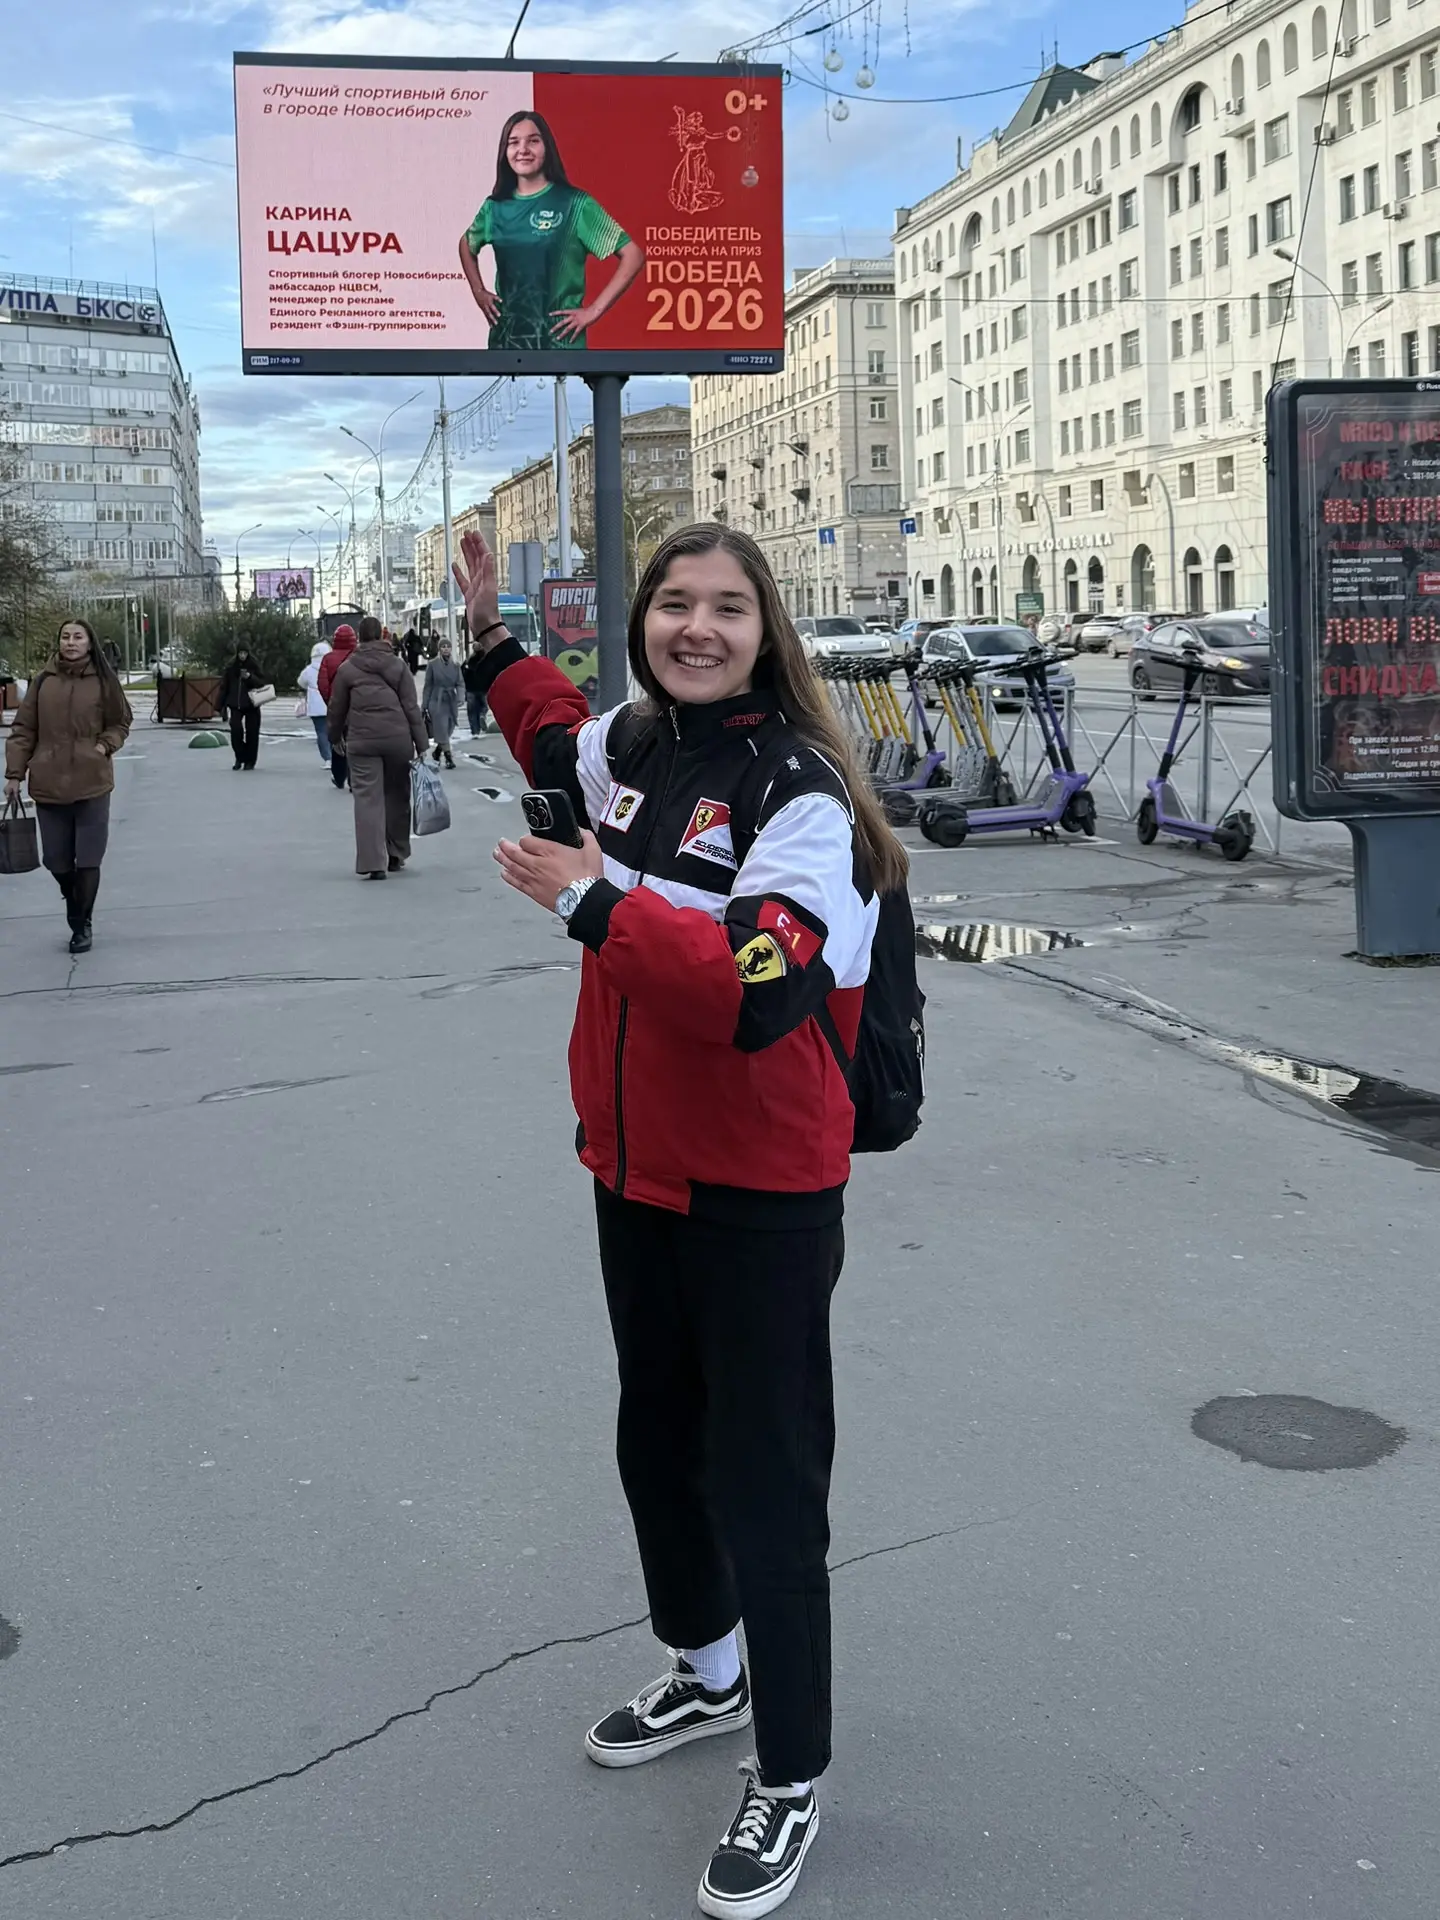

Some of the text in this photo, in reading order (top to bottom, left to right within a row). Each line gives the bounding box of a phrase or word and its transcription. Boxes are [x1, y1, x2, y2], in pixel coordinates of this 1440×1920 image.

[263, 84, 488, 101] «Лучший спортивный блог
[724, 89, 768, 115] 0+
[264, 103, 472, 119] в городе Новосибирске»
[266, 206, 352, 221] КАРИНА
[267, 230, 403, 256] ЦАЦУРА
[645, 226, 762, 244] ПОБЕДИТЕЛЬ
[646, 246, 762, 256] КОНКУРСА НА ПРИЗ
[268, 269, 467, 282] Спортивный блогер Новосибирска,
[646, 260, 763, 287] ПОБЕДА
[268, 283, 382, 293] амбассадор НЦВСМ,
[77, 297, 133, 320] БКС
[269, 296, 395, 306] менеджер по рекламе
[269, 307, 446, 319] Единого Рекламного агентства,
[646, 288, 764, 331] 2026
[270, 320, 447, 331] резидент «Фэшн-группировки»
[1323, 616, 1398, 644] ЛОВИ
